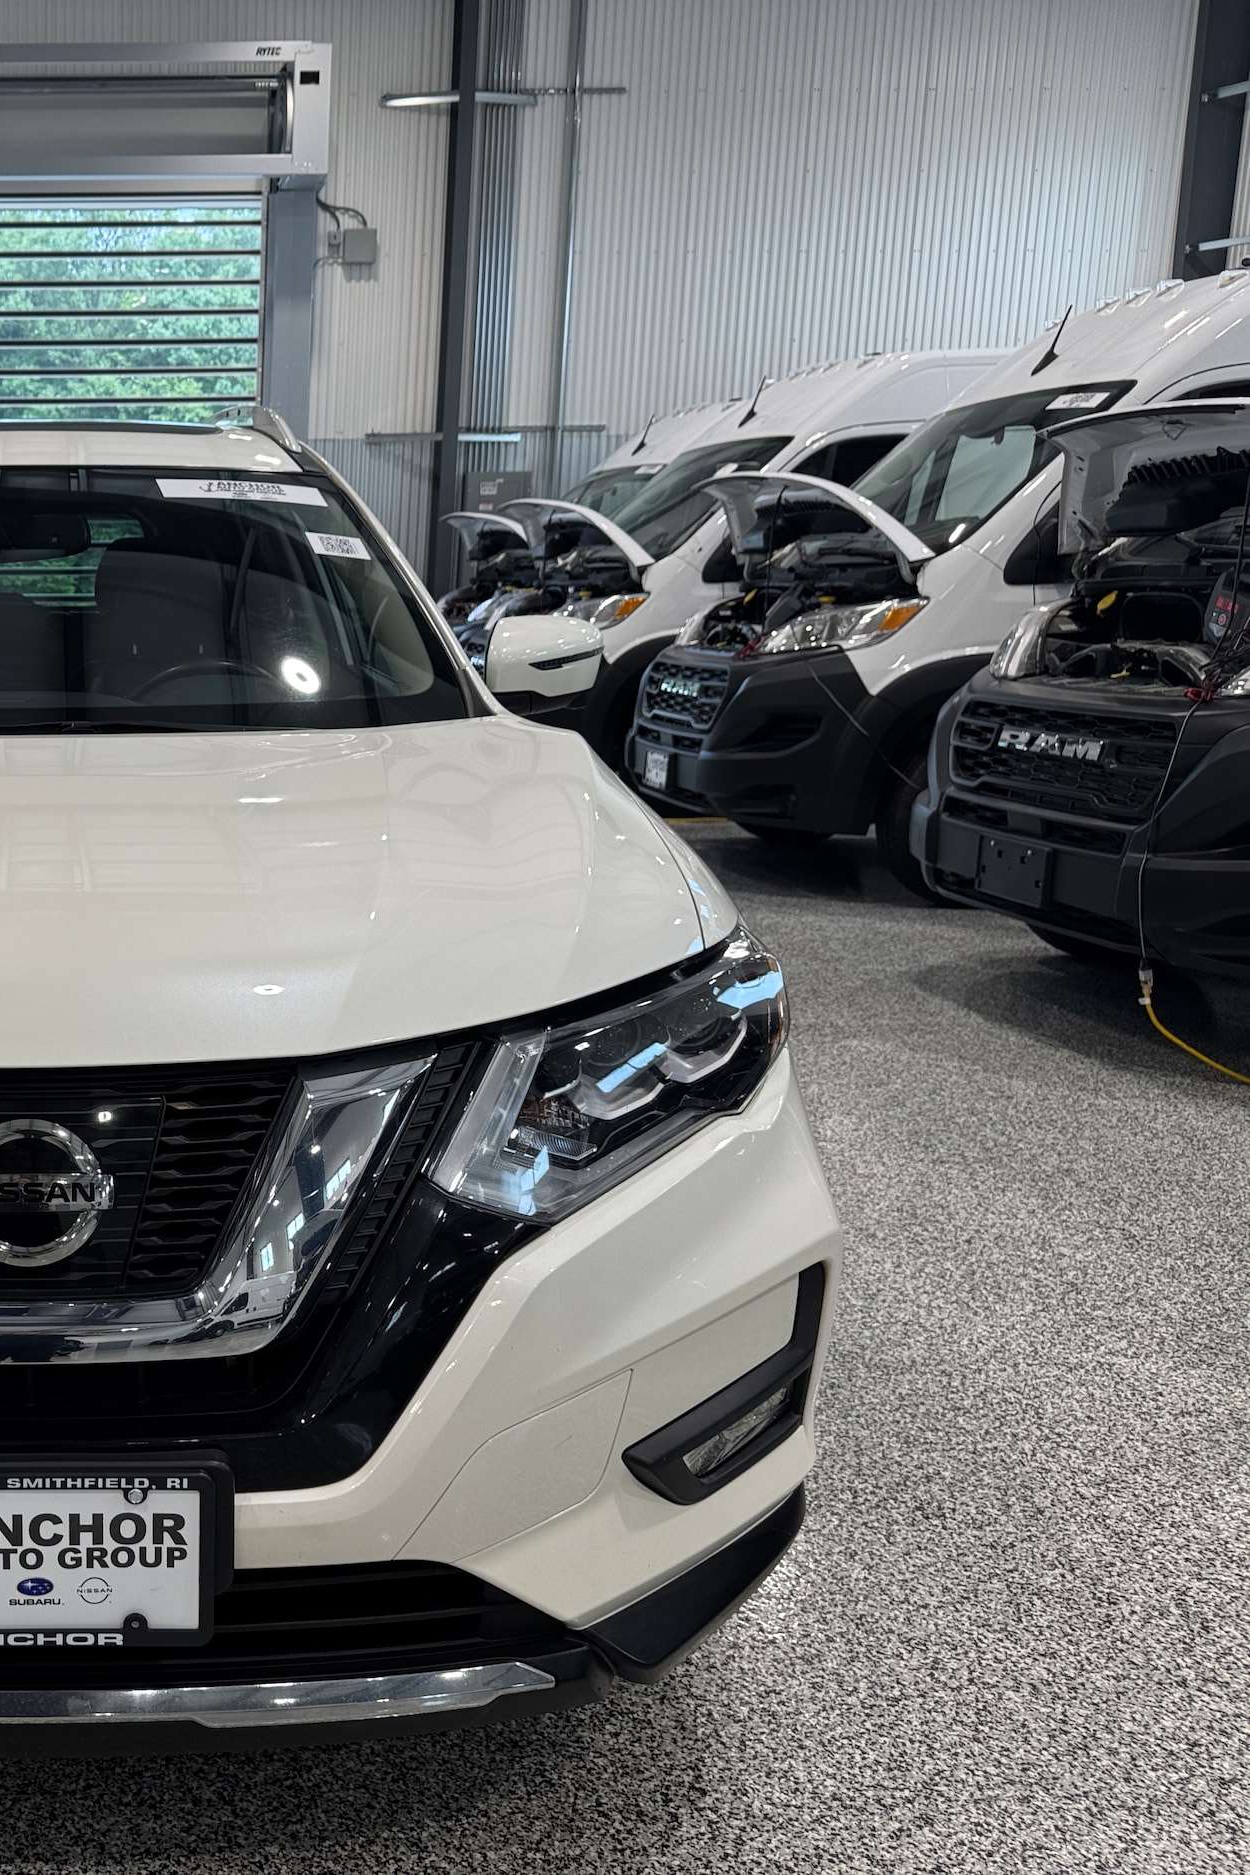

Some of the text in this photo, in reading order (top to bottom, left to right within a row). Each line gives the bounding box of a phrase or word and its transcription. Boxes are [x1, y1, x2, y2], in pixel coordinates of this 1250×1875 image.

[255, 47, 281, 56] RYTEC
[997, 726, 1103, 761] RAM
[7, 1476, 156, 1490] SMITHFIELD,
[167, 1477, 189, 1489] RI
[57, 1546, 188, 1569] GROUP
[9, 1598, 61, 1606] SUBARU
